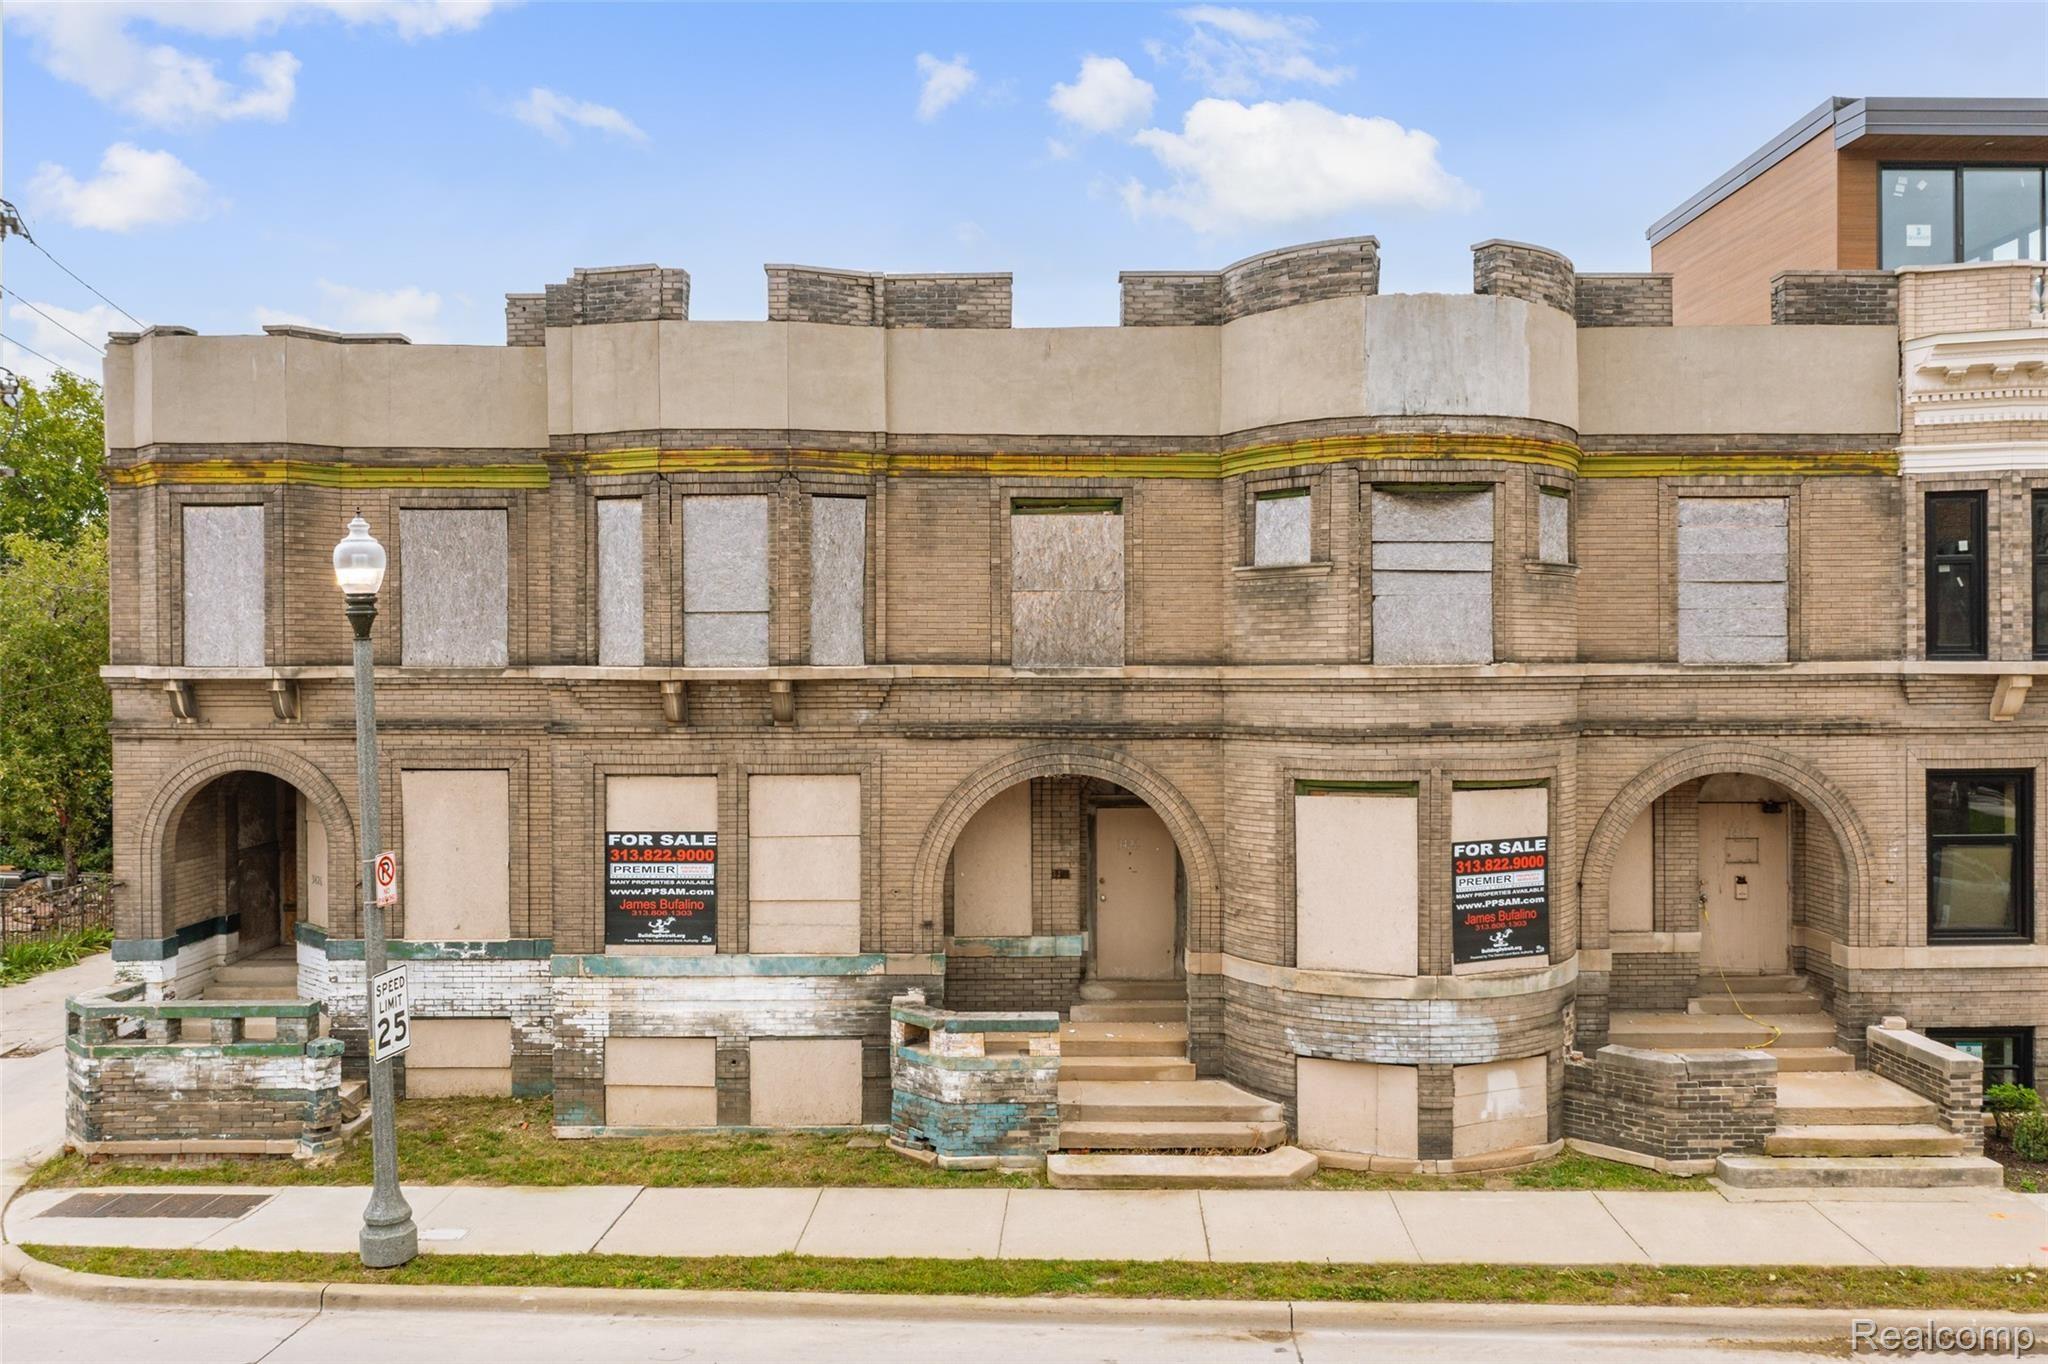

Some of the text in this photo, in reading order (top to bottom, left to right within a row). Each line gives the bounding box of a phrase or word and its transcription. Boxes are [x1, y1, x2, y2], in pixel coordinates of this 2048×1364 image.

[608, 834, 717, 846] FOR SALE
[1454, 839, 1546, 857] FOR SALE
[610, 849, 715, 862] 313.822.9000
[613, 865, 675, 874] PREMIER
[1456, 855, 1544, 874] 313.822.9000
[1459, 874, 1512, 886] PREMIER
[610, 888, 715, 896] www.PPSAM.com
[1474, 890, 1511, 898] PROPERTIES
[1512, 887, 1545, 895] AVAILABLE
[620, 898, 704, 910] James Bufalino
[1456, 897, 1545, 910] www.PPSAM.com
[1464, 909, 1537, 925] James Bufalino
[376, 976, 405, 998] SPEED
[379, 994, 402, 1014] LIMIT
[377, 1010, 407, 1050] 25
